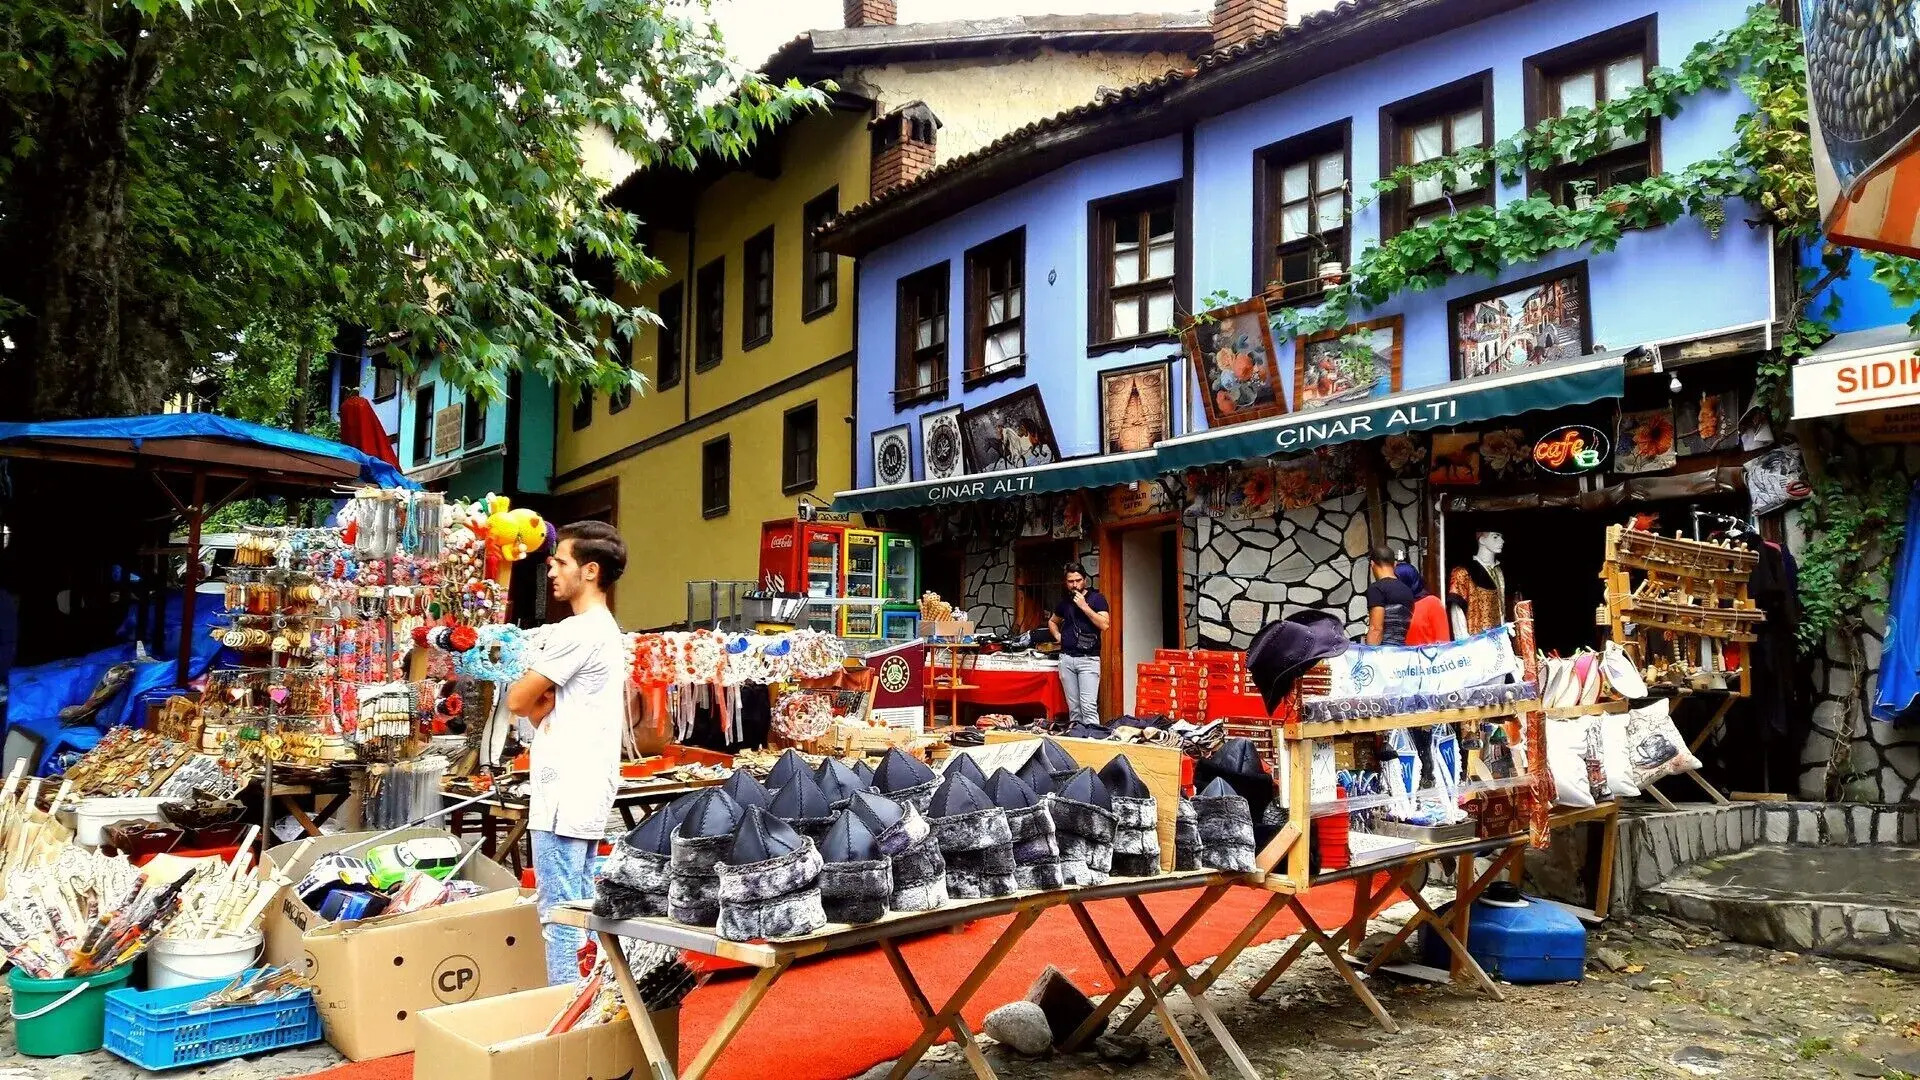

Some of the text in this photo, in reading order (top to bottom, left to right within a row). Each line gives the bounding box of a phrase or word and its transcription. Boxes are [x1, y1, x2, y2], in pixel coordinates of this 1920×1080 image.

[1385, 400, 1457, 428] ALTI
[1536, 430, 1585, 466] cafe
[992, 476, 1034, 494] ALTI
[438, 967, 474, 993] CP
